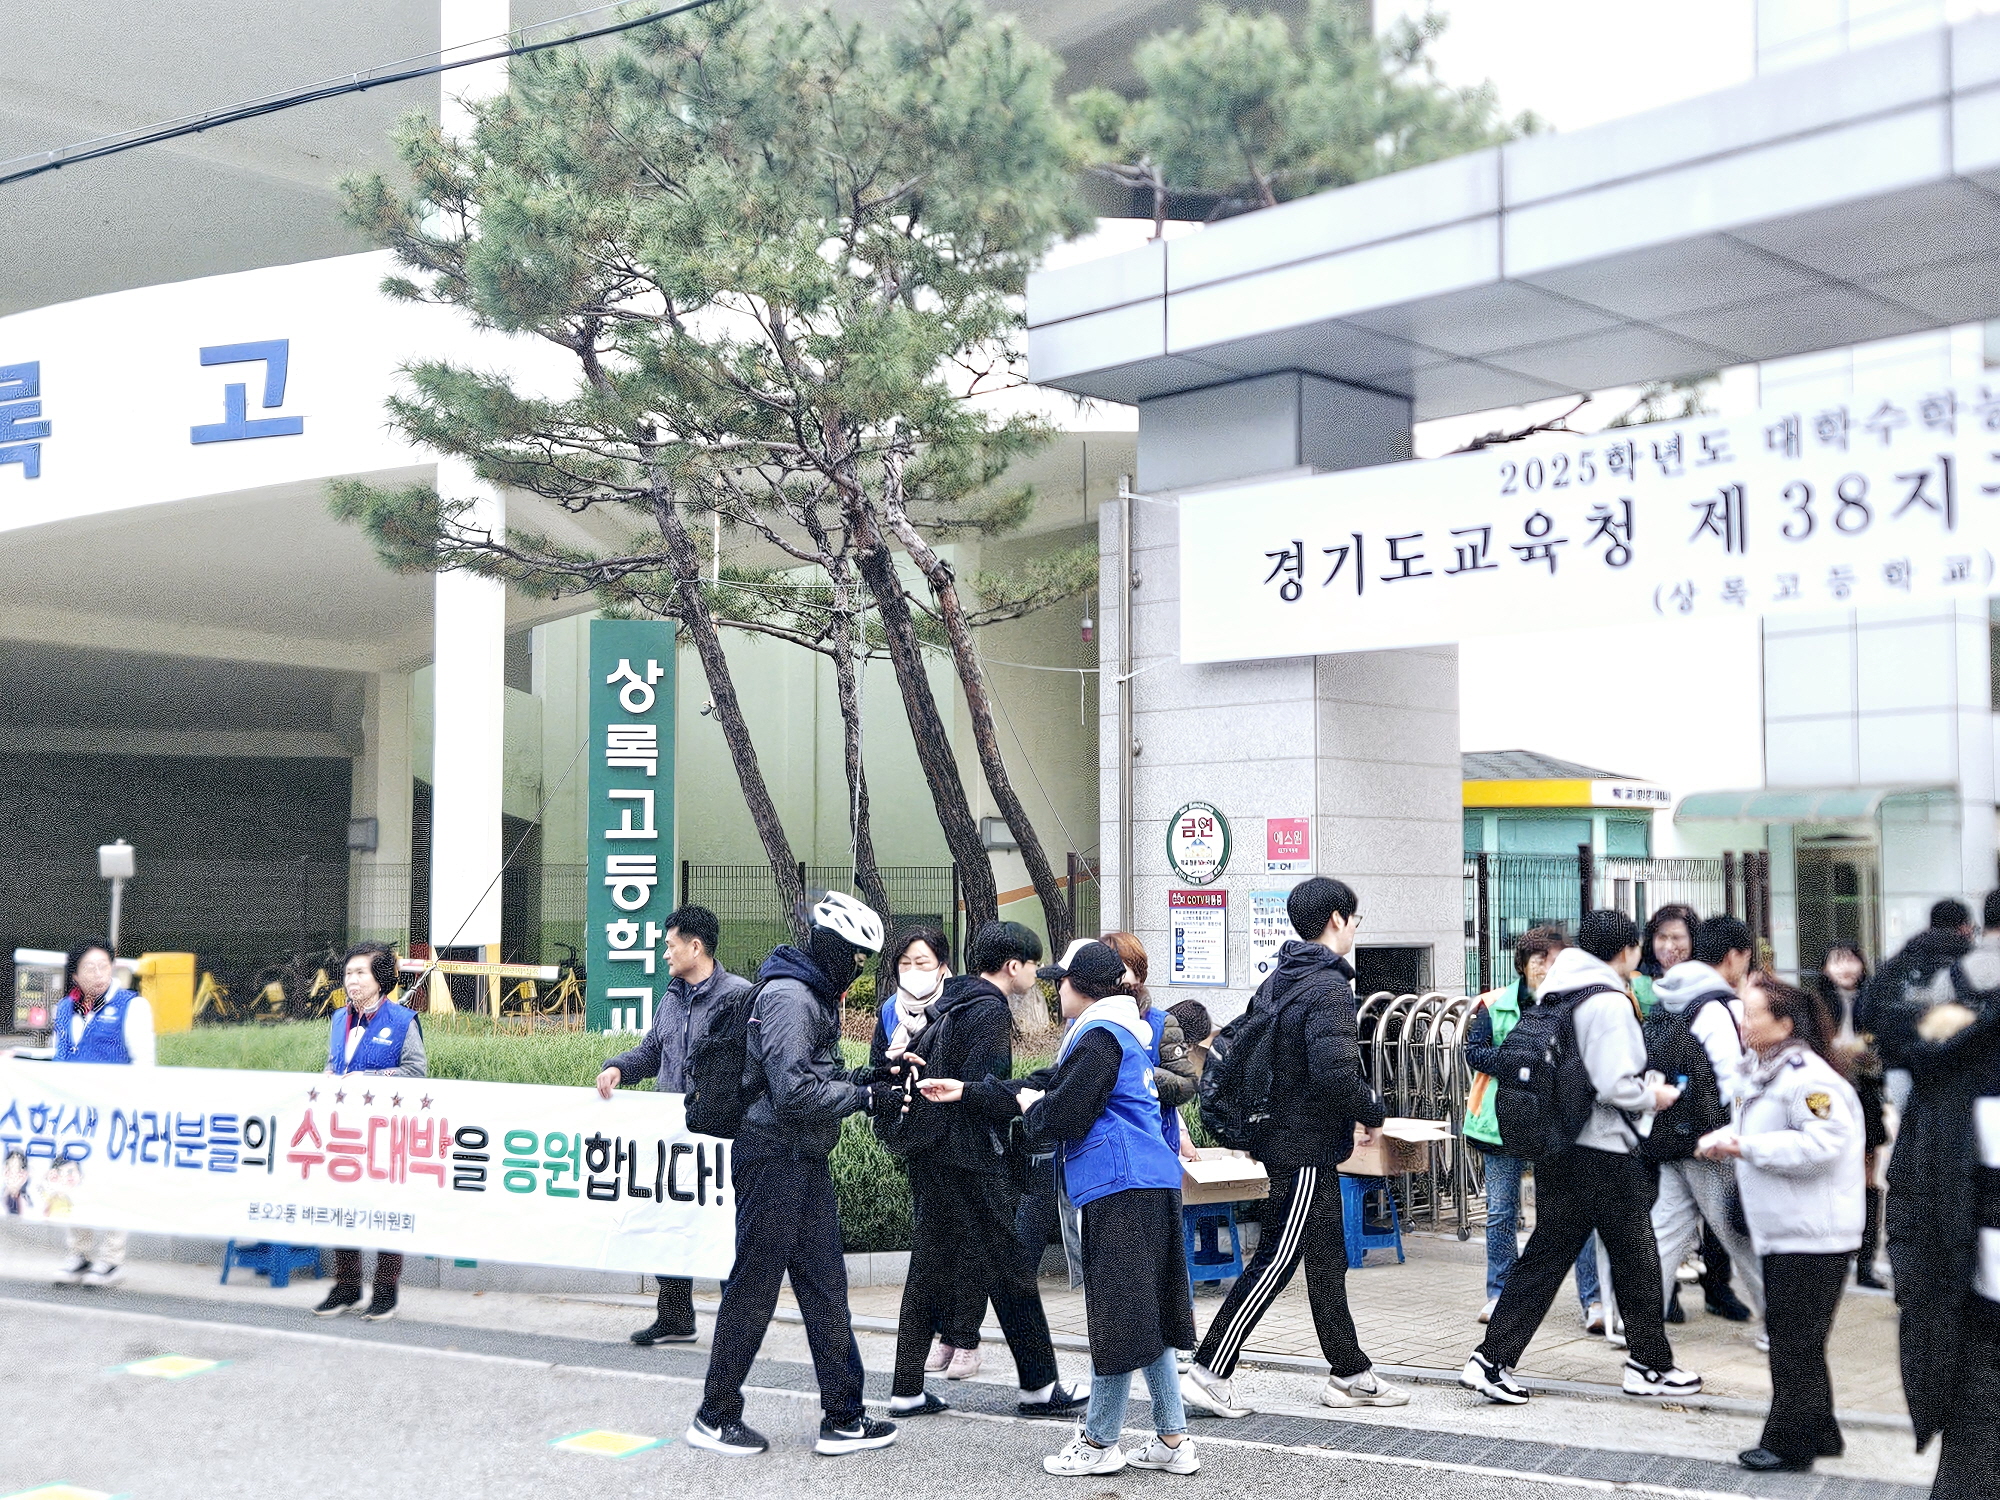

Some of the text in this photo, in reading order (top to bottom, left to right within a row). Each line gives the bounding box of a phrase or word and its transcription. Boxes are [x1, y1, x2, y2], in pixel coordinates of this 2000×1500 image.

[1499, 430, 1736, 496] 2025학년도
[1263, 496, 1635, 602] 경기도교육청
[604, 658, 665, 1034] 상록고등학교
[1181, 816, 1213, 838] 금연
[1273, 830, 1303, 845] 에스원
[106, 1107, 277, 1175] 여러분들의
[286, 1107, 490, 1193] 수능대박을
[501, 1129, 725, 1207] 응원합니다!
[247, 1201, 417, 1234] 본오2동 바르게살기위원회
